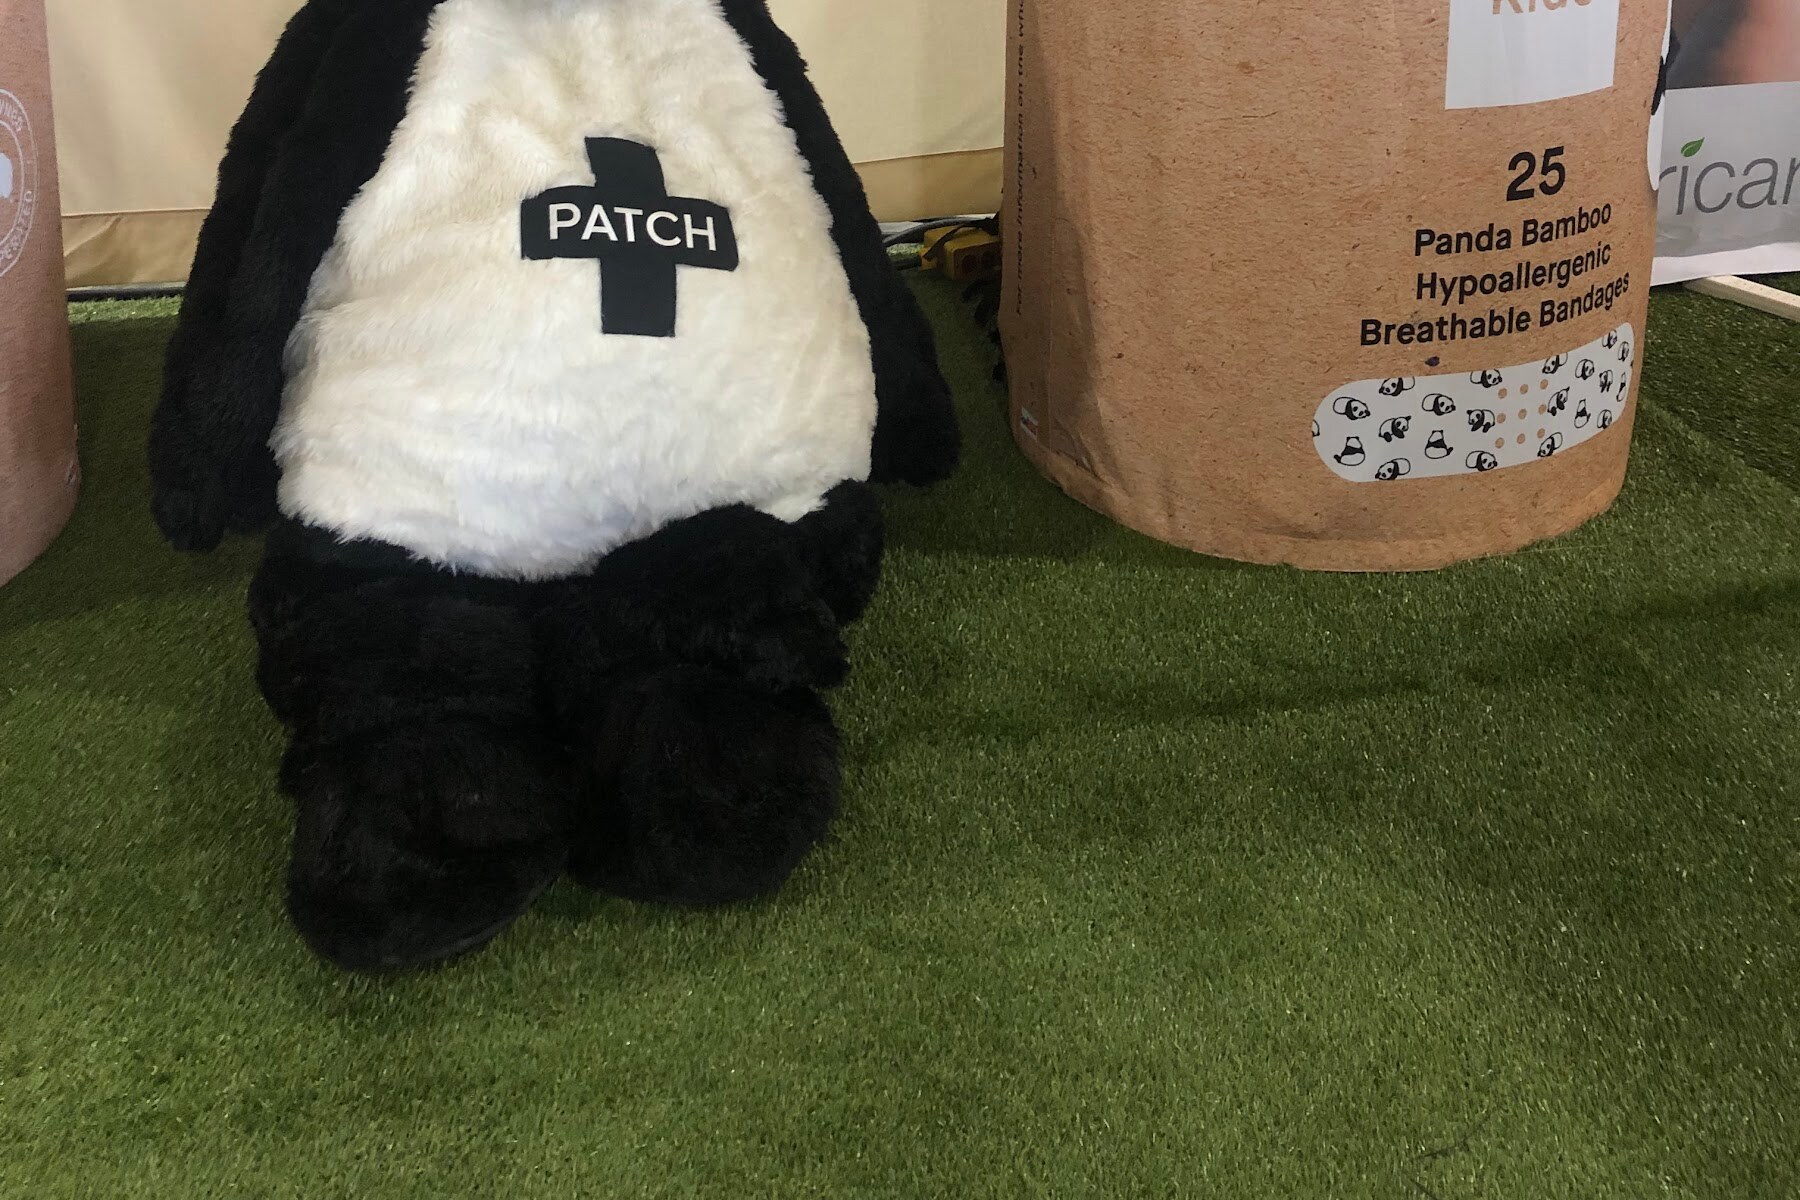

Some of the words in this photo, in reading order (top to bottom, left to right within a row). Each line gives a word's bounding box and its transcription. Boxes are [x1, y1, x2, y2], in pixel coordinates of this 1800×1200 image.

[1506, 146, 1567, 201] 25
[549, 202, 717, 251] PATCH
[1414, 222, 1512, 257] Panda
[1522, 203, 1612, 247] Bamboo
[1416, 241, 1612, 306] Hypoallergenic
[1360, 308, 1530, 346] Breathable
[1539, 271, 1630, 327] Bandages
